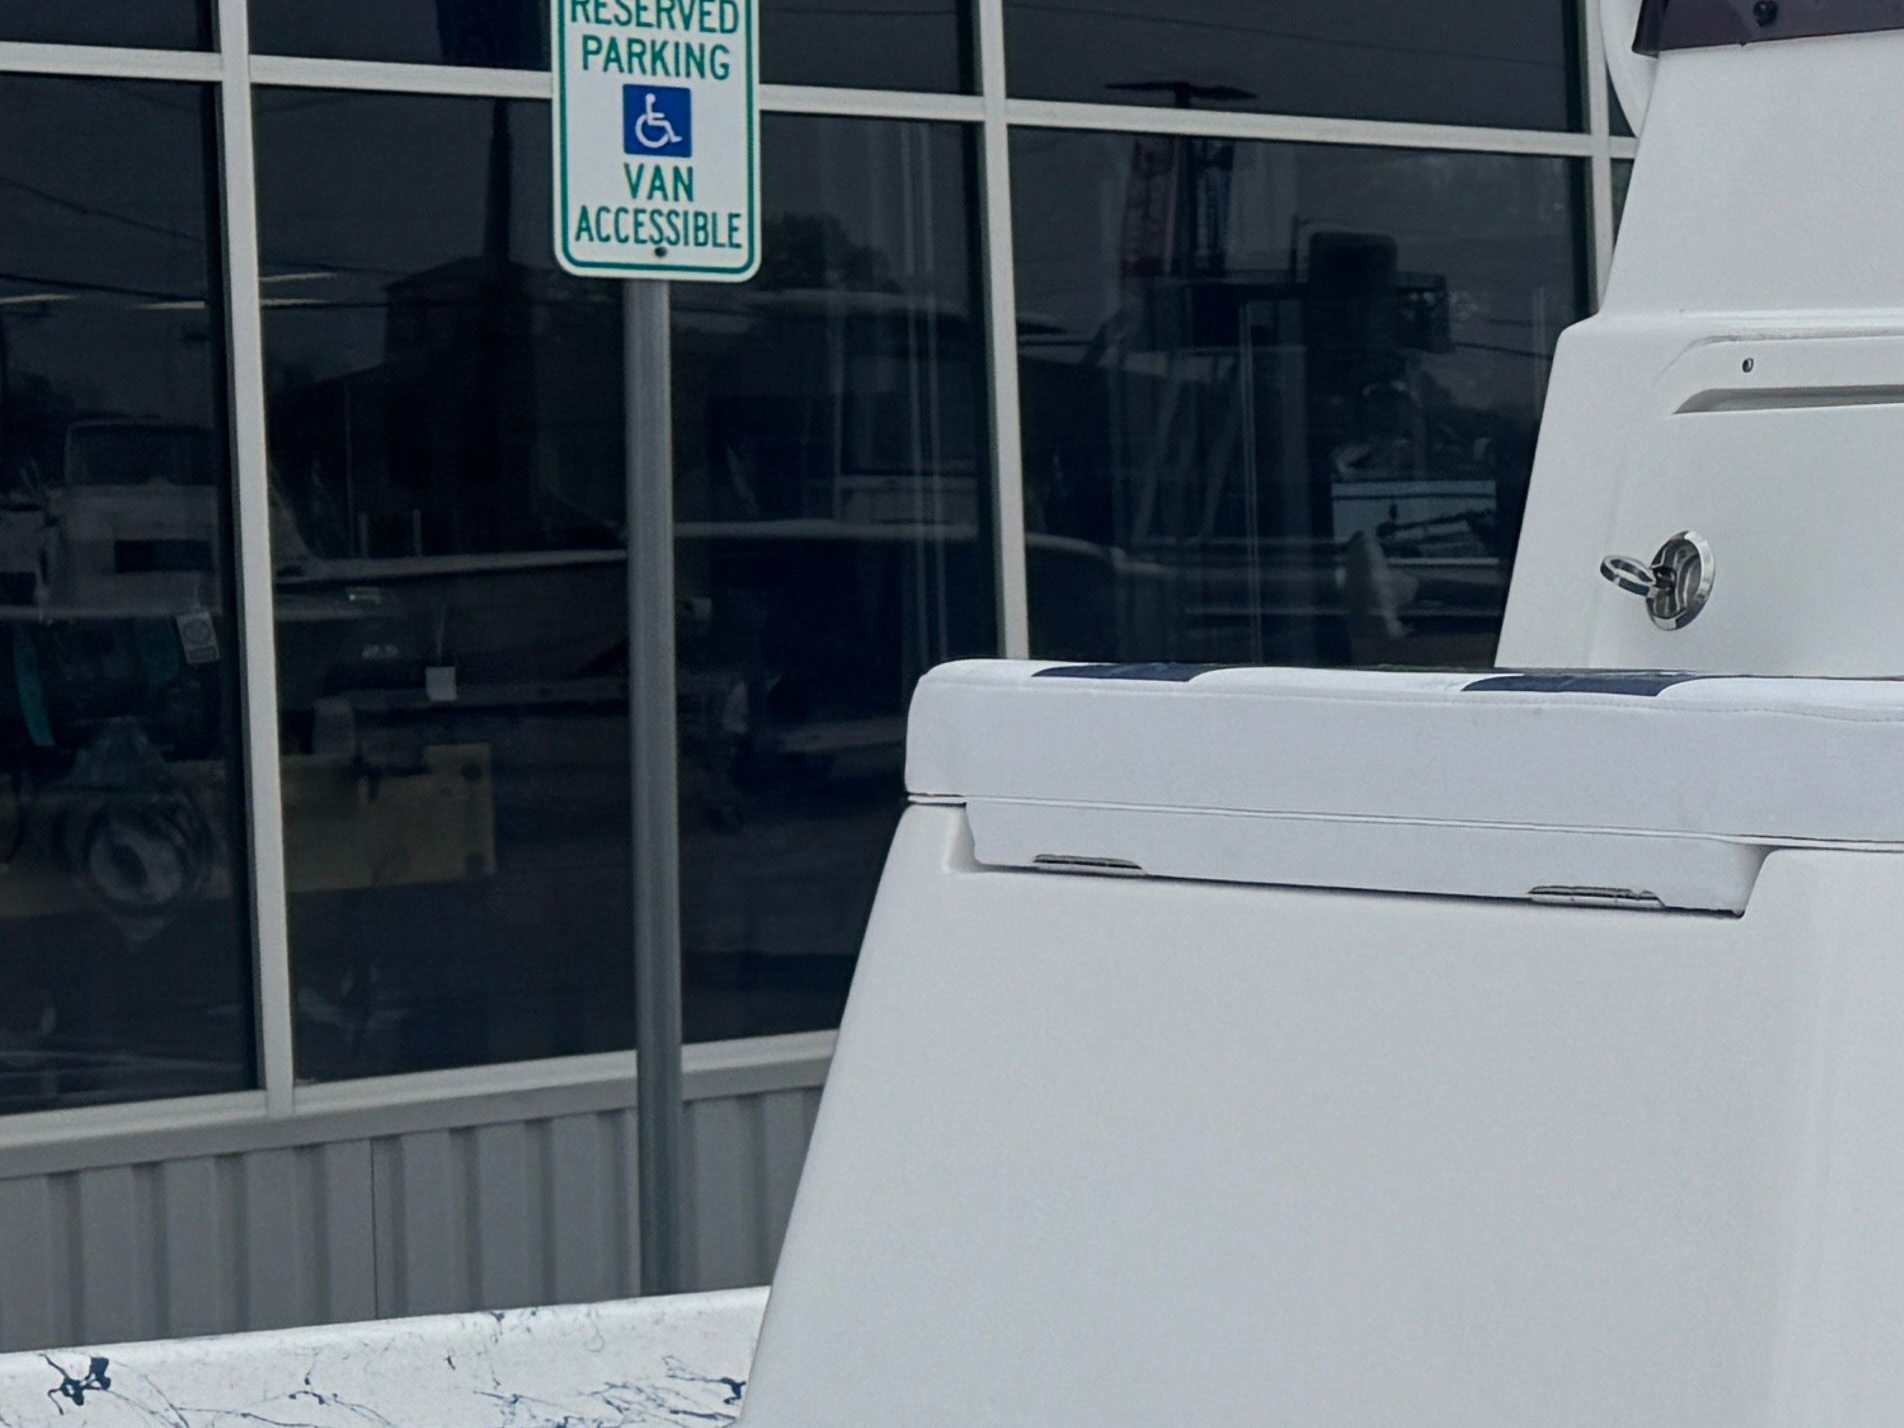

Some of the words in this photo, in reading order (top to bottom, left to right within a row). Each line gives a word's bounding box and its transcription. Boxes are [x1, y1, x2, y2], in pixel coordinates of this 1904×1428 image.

[582, 35, 731, 80] PARKING
[623, 164, 694, 202] VAN
[575, 205, 742, 249] ACCESSIBLE
